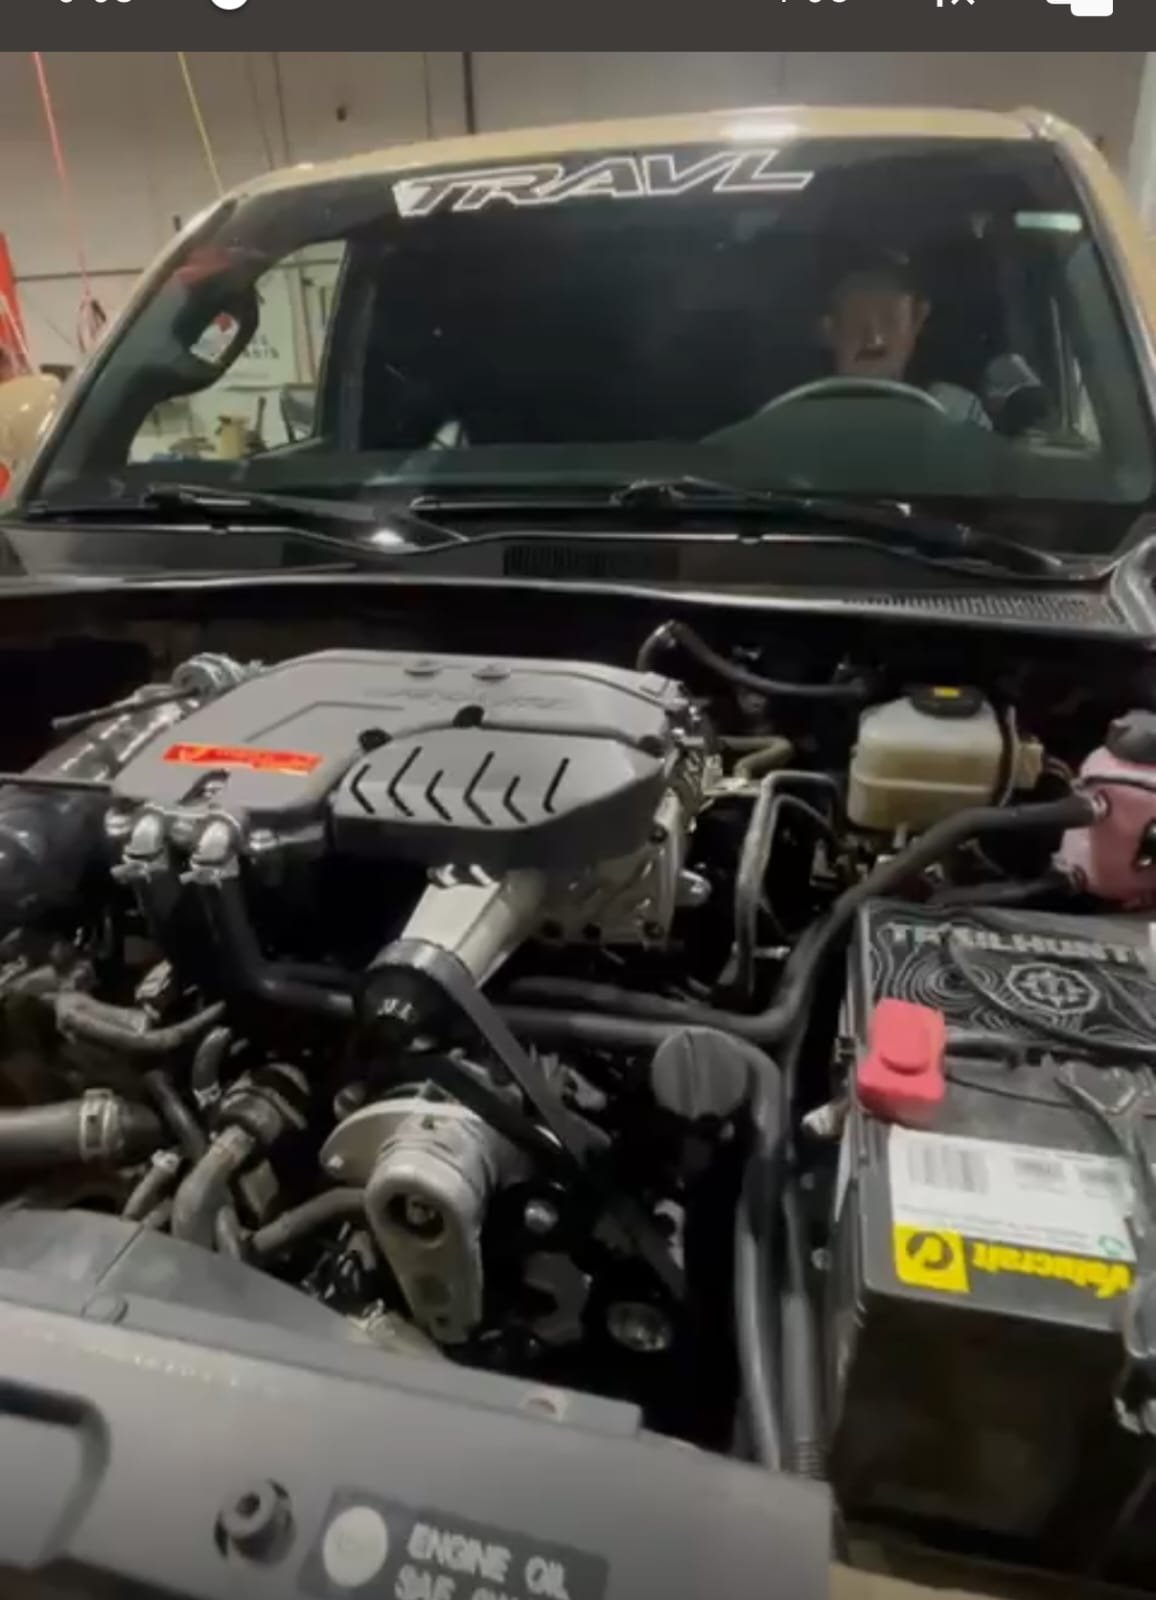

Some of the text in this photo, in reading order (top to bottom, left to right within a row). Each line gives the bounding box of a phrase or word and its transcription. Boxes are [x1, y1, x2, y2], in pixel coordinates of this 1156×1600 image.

[392, 149, 815, 218] TRAVL
[407, 1522, 571, 1600] ENGINE OIL
